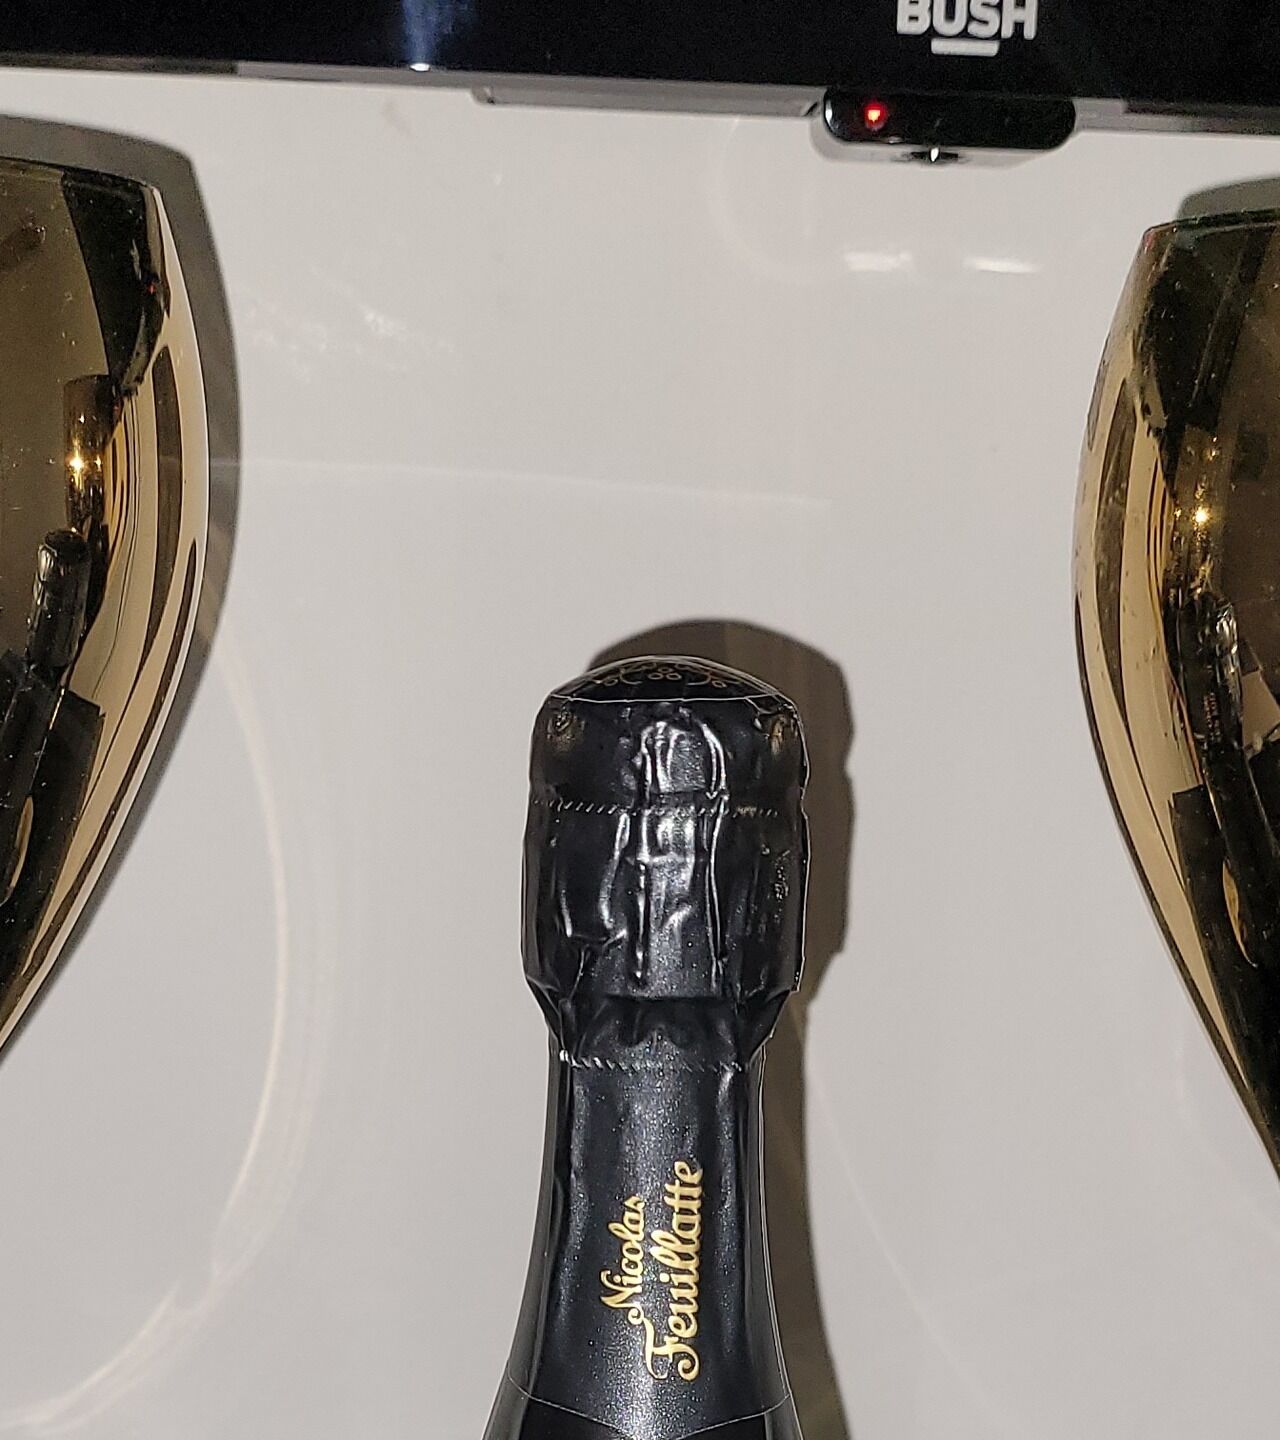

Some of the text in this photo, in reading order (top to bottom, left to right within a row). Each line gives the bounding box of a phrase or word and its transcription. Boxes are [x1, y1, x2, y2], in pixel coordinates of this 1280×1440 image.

[896, 0, 1039, 41] BUSH
[600, 1194, 646, 1326] Nicolas
[641, 1159, 705, 1382] Feuillatte
